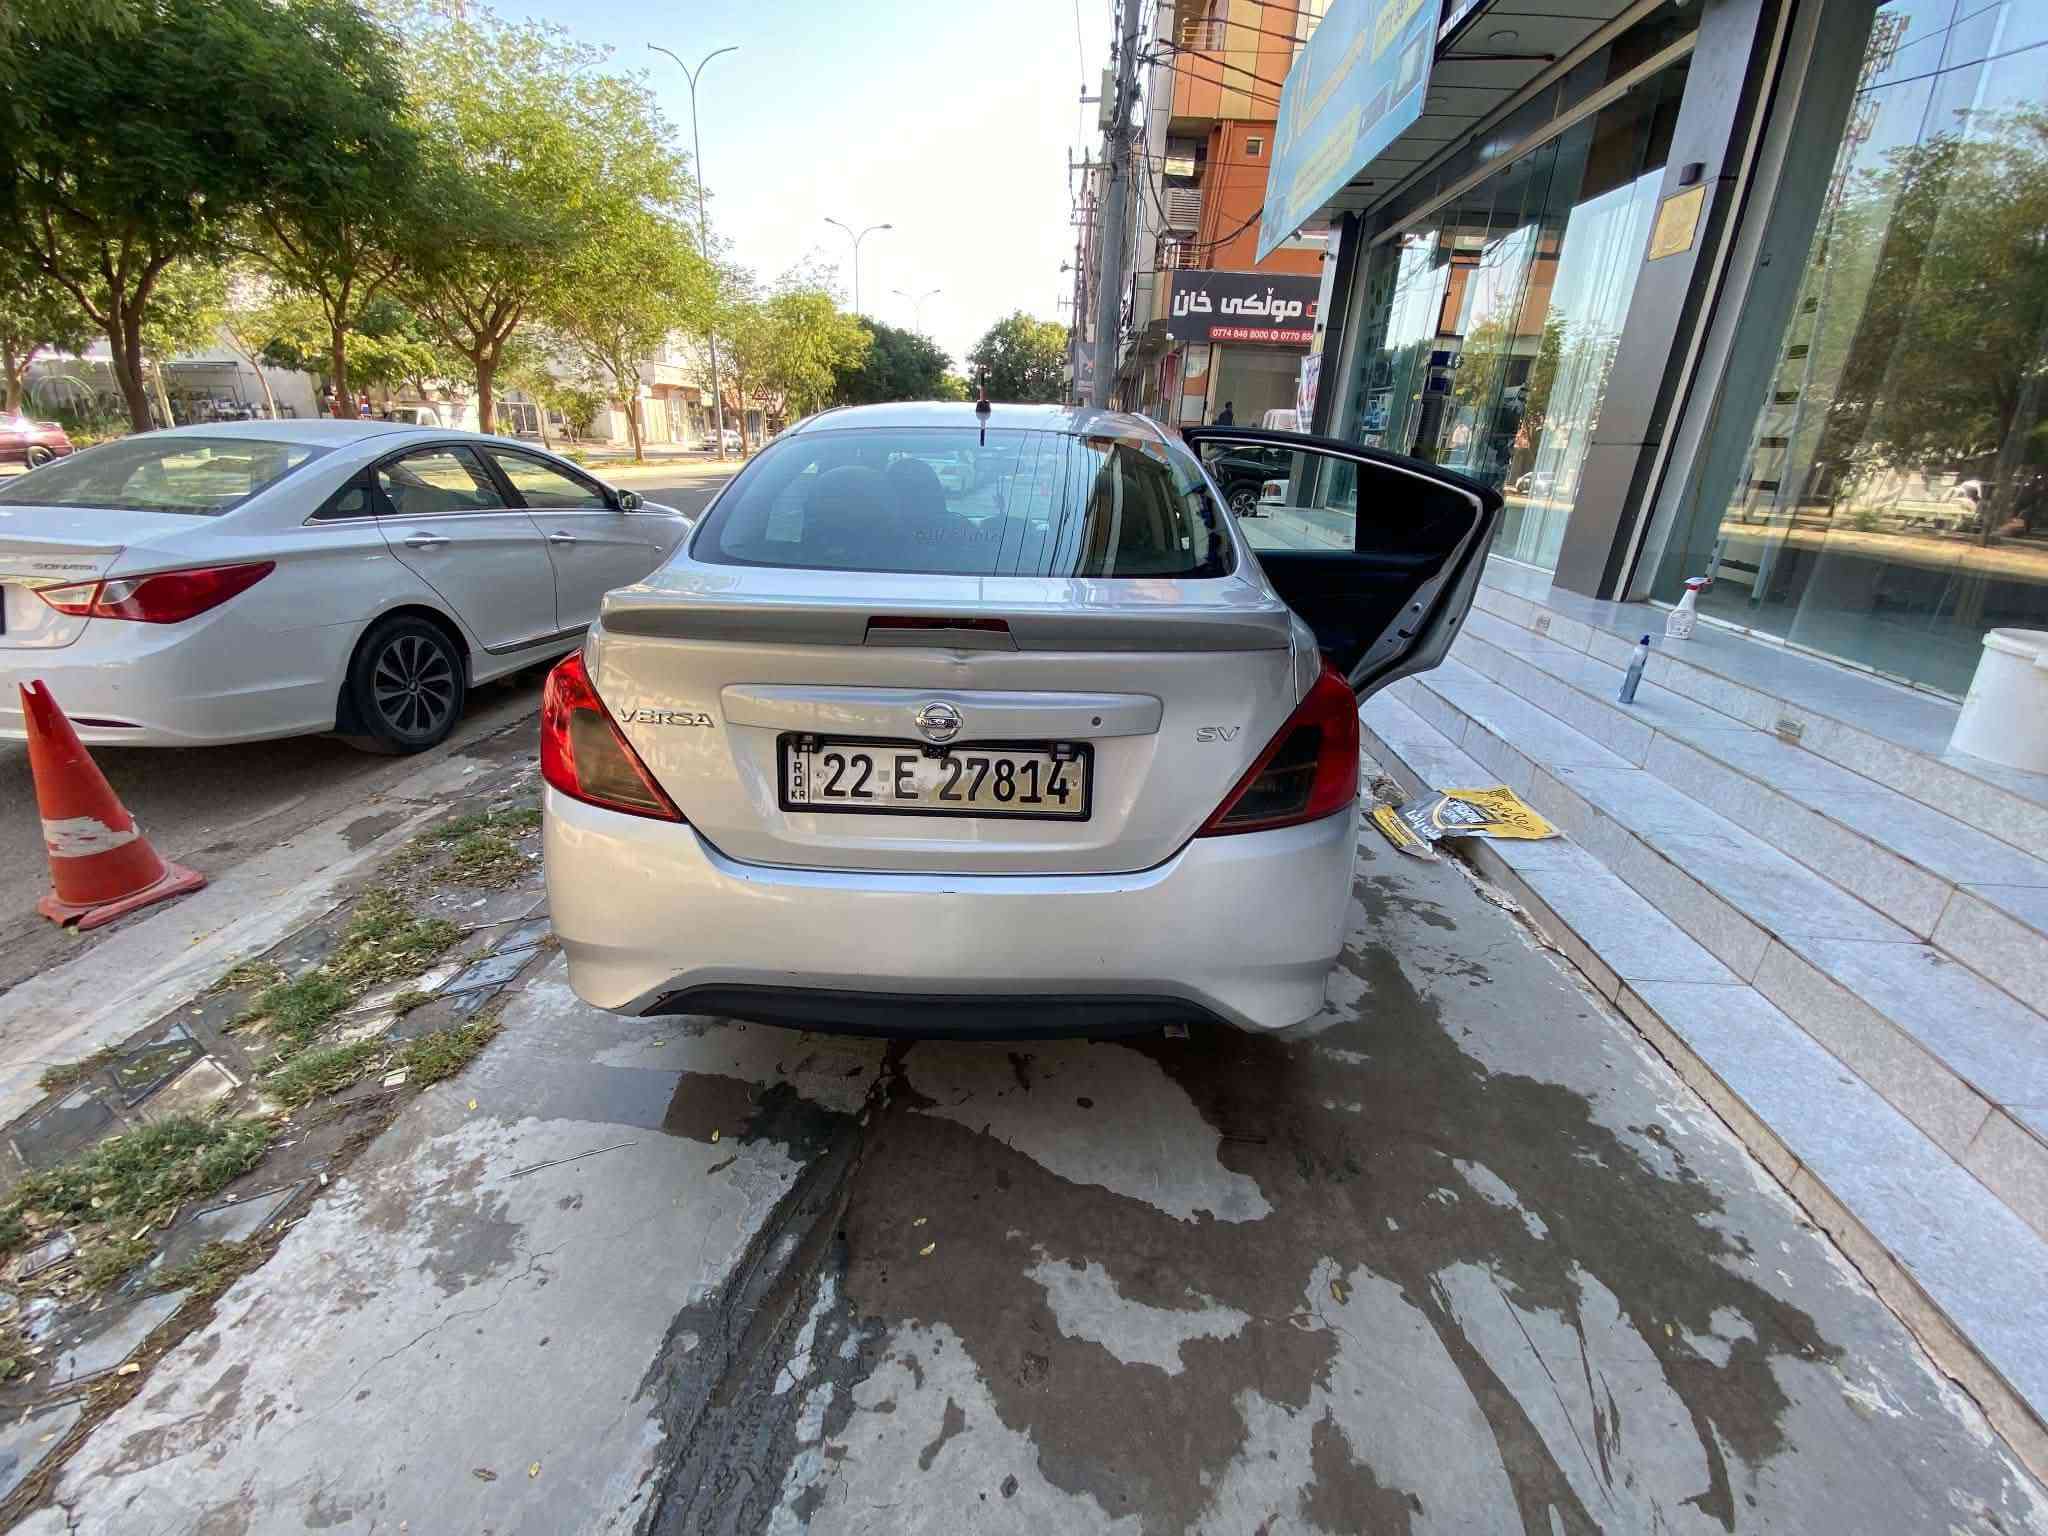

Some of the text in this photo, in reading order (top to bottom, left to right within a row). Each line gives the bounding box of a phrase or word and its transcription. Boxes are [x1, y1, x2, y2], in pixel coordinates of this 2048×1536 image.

[1172, 289, 1213, 316] خان
[620, 708, 715, 728] VERSA
[1197, 727, 1241, 742] SV
[823, 753, 1069, 804] 22 E 27814
[791, 790, 806, 800] KR
